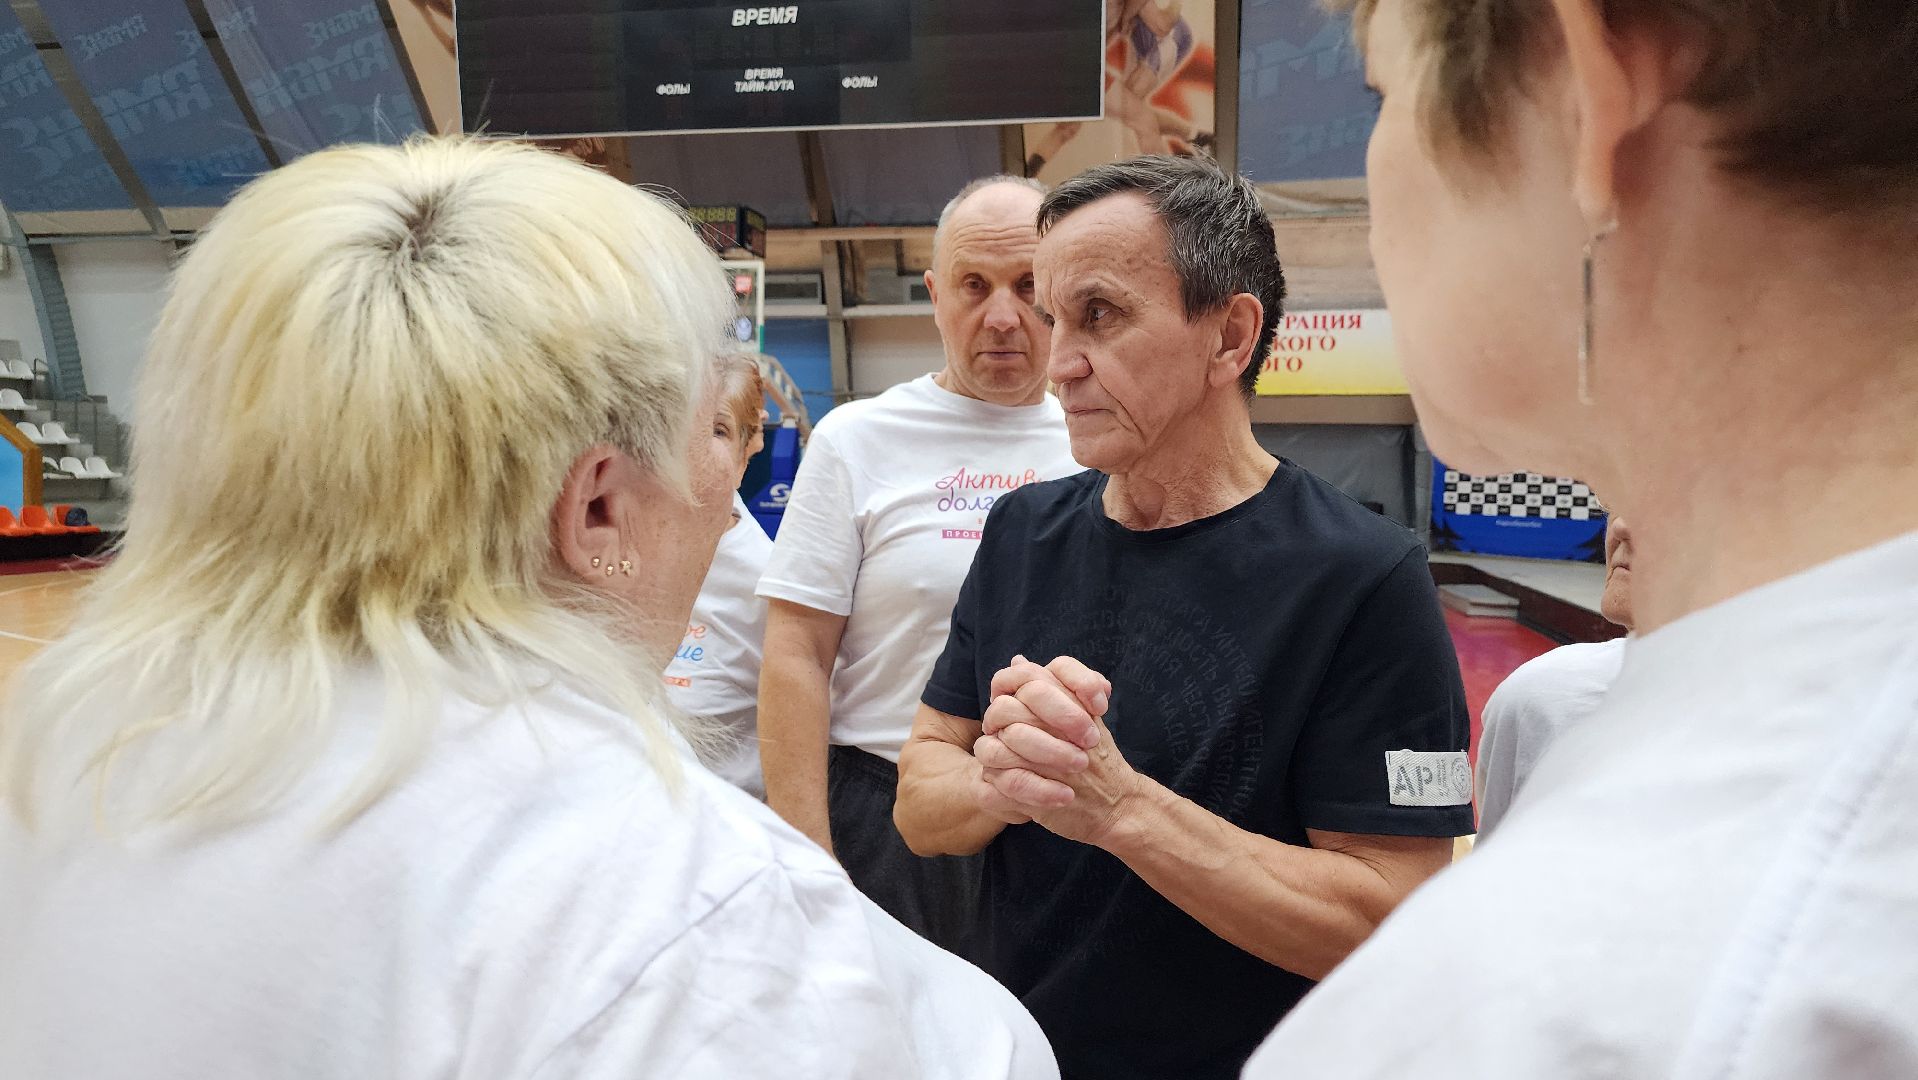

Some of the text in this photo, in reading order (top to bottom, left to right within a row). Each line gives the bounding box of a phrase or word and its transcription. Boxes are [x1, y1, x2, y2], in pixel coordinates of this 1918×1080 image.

[732, 6, 798, 26] ВРЕМЯ
[744, 67, 783, 80] ВРЕМЯ
[656, 83, 690, 95] ФОЛЫ
[734, 80, 794, 93] ТАЙМ-АУТА
[842, 76, 878, 89] ФОЛЫ
[1285, 314, 1362, 331] РАЦИЯ
[1273, 335, 1336, 351] КОГО
[935, 467, 1043, 490] Актив
